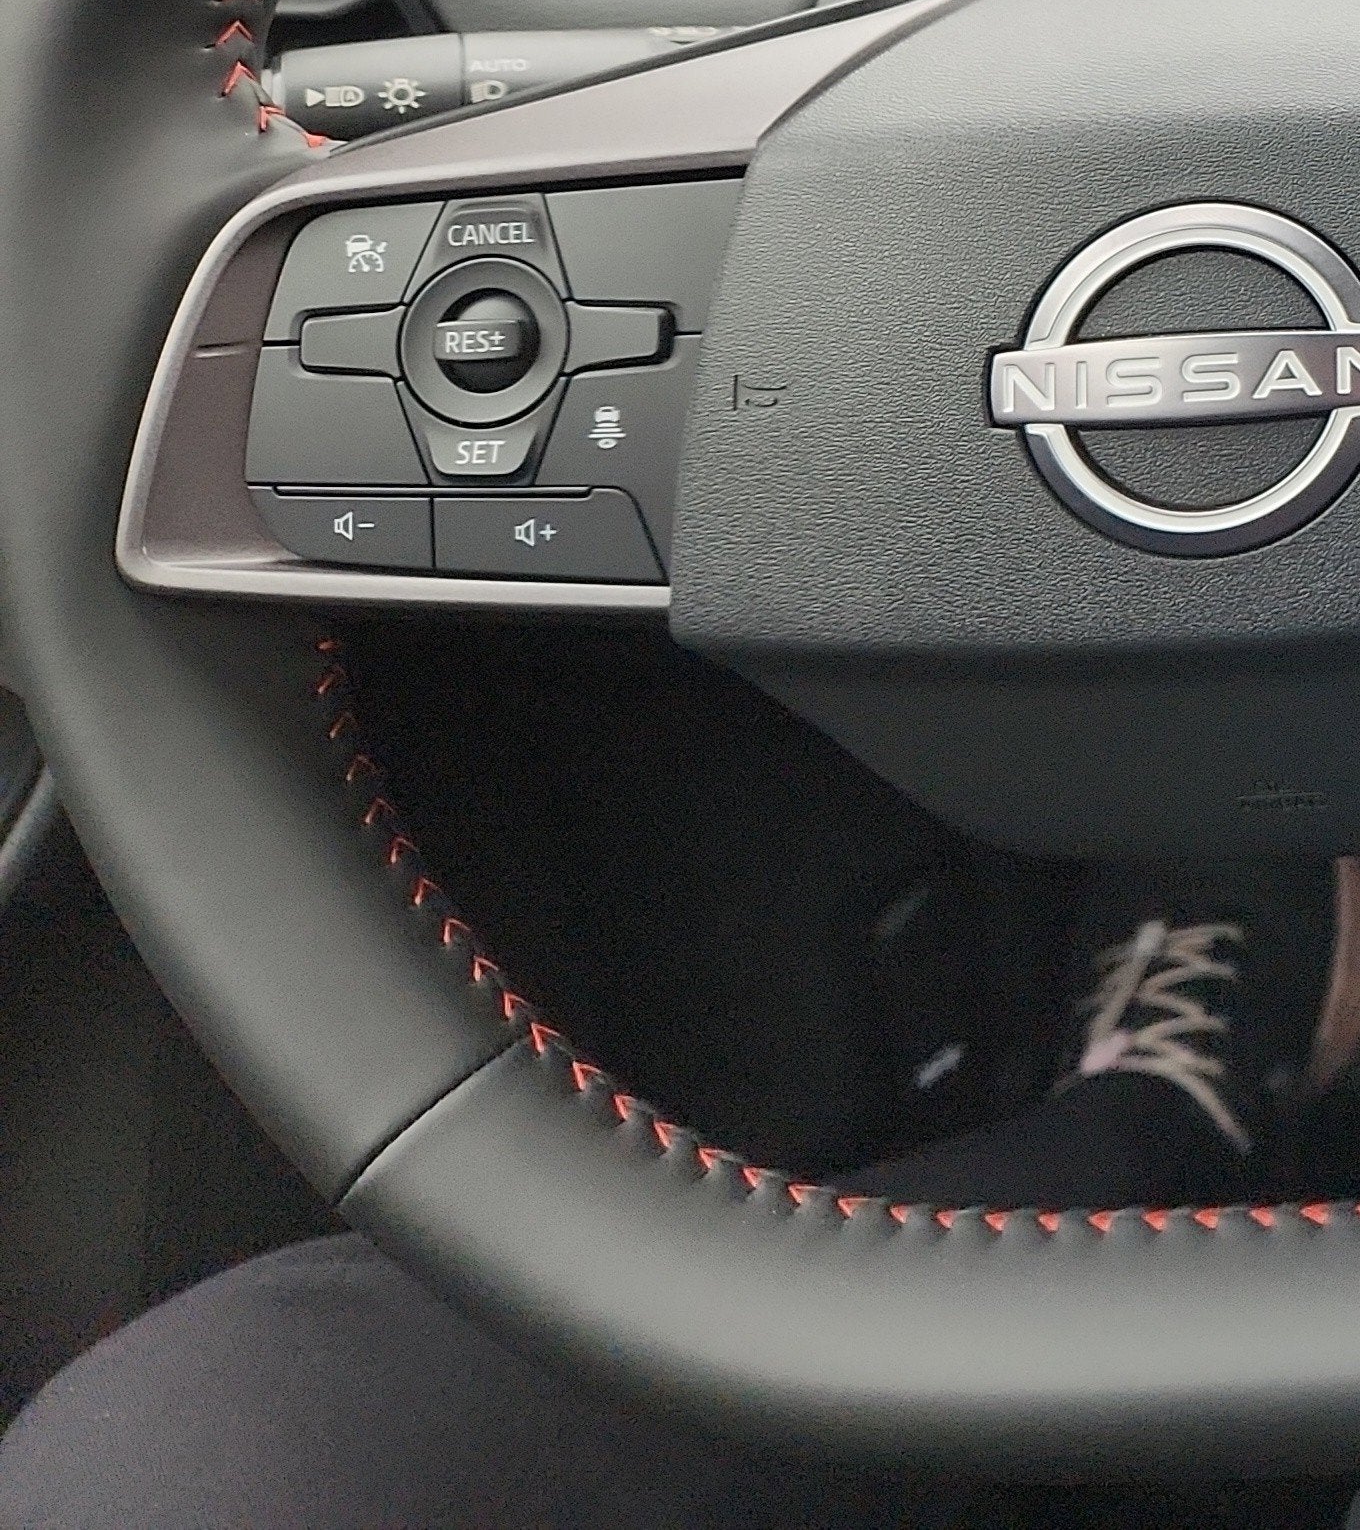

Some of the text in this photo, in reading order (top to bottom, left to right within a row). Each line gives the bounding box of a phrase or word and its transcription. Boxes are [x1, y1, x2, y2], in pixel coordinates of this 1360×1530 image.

[470, 57, 528, 73] AUTO
[447, 221, 535, 247] CANCEL
[455, 439, 506, 465] SET
